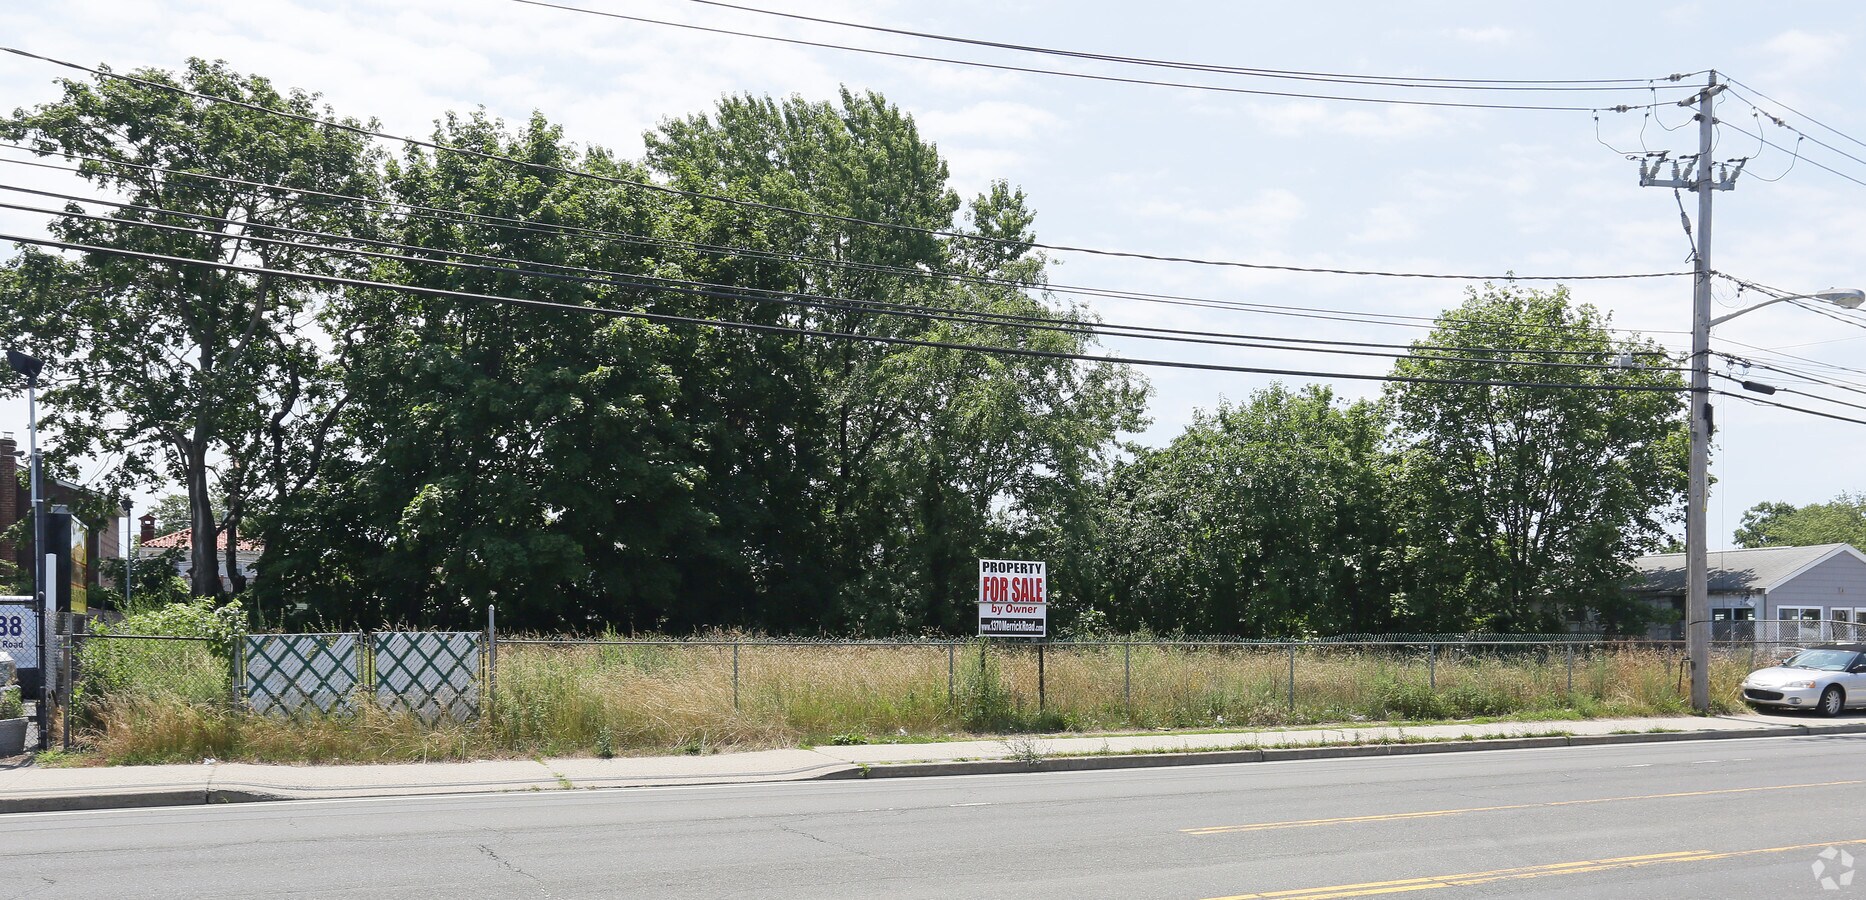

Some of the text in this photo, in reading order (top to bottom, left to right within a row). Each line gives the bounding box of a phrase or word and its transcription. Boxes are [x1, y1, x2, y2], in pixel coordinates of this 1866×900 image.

[982, 562, 1042, 574] PROPERTY
[983, 576, 1042, 602] FOR SALE
[991, 604, 1038, 615] by Owner
[2, 640, 24, 648] Road
